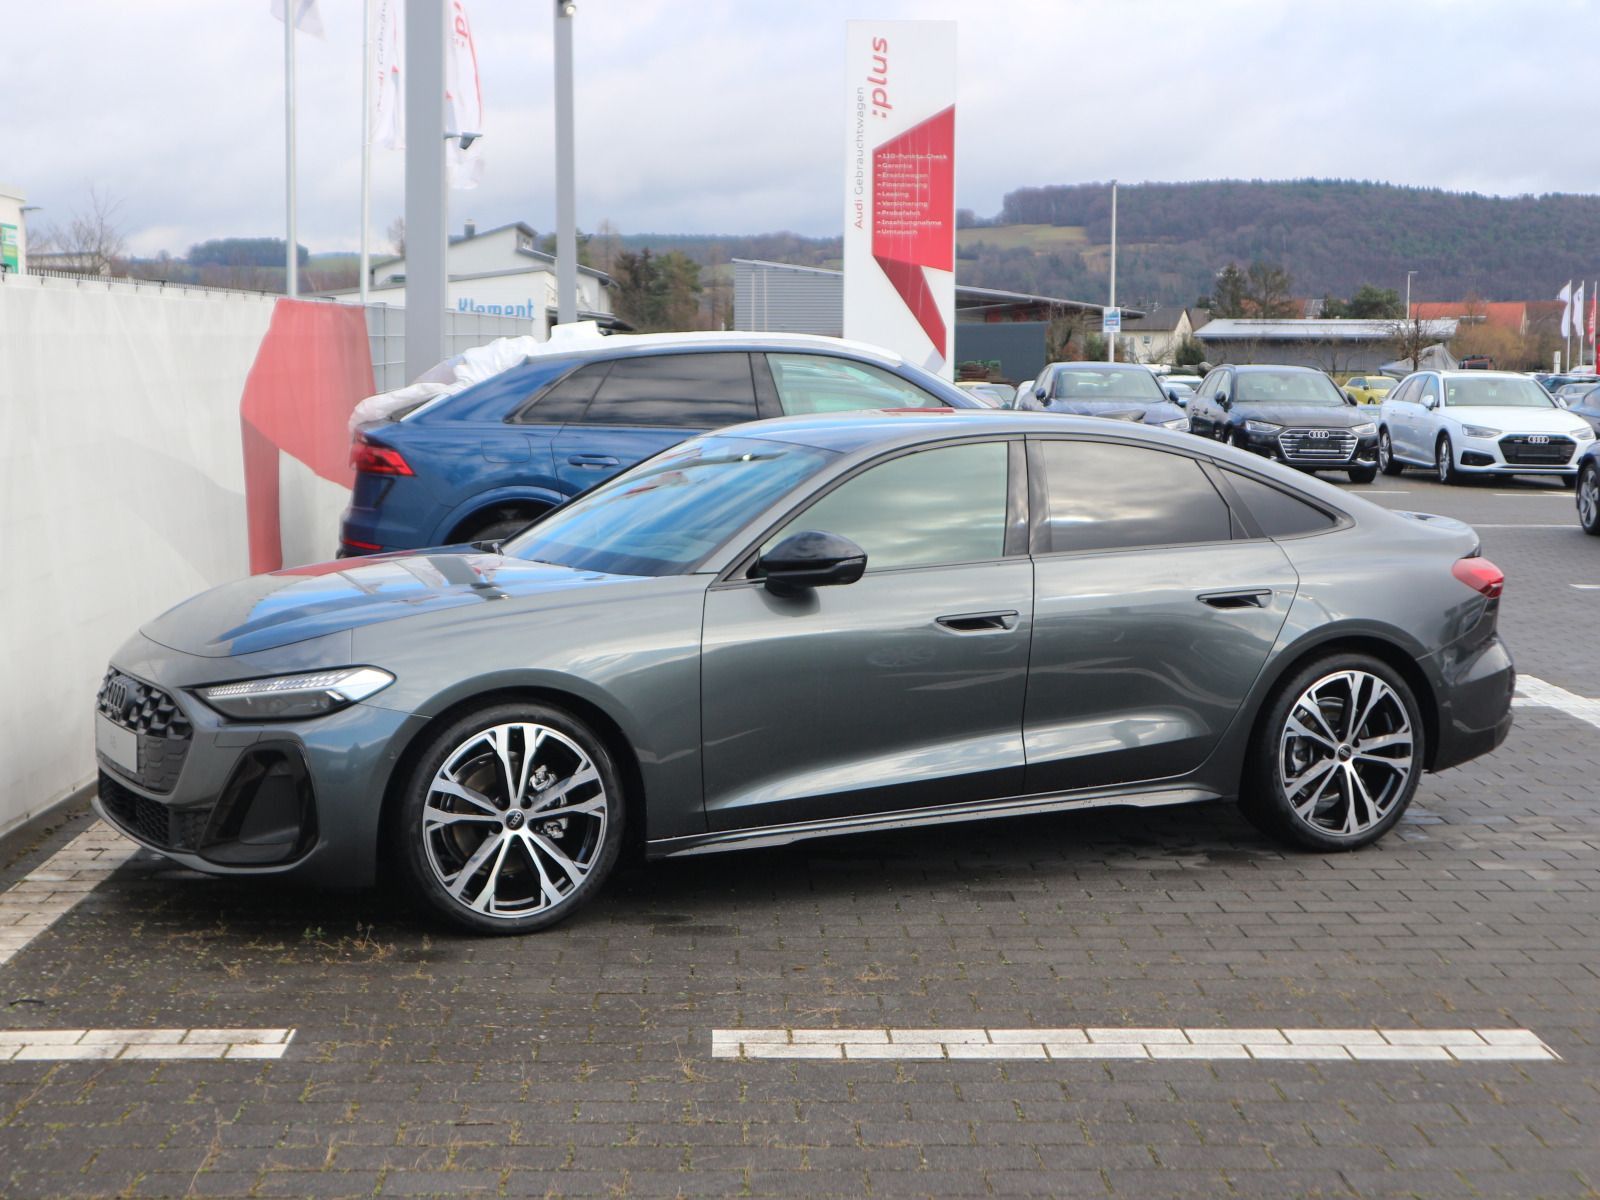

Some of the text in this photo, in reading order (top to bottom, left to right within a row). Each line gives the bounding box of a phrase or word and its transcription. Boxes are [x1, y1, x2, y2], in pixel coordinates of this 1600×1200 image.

[866, 36, 893, 118] :plus
[854, 86, 866, 229] Audi Gebrauchtwagen
